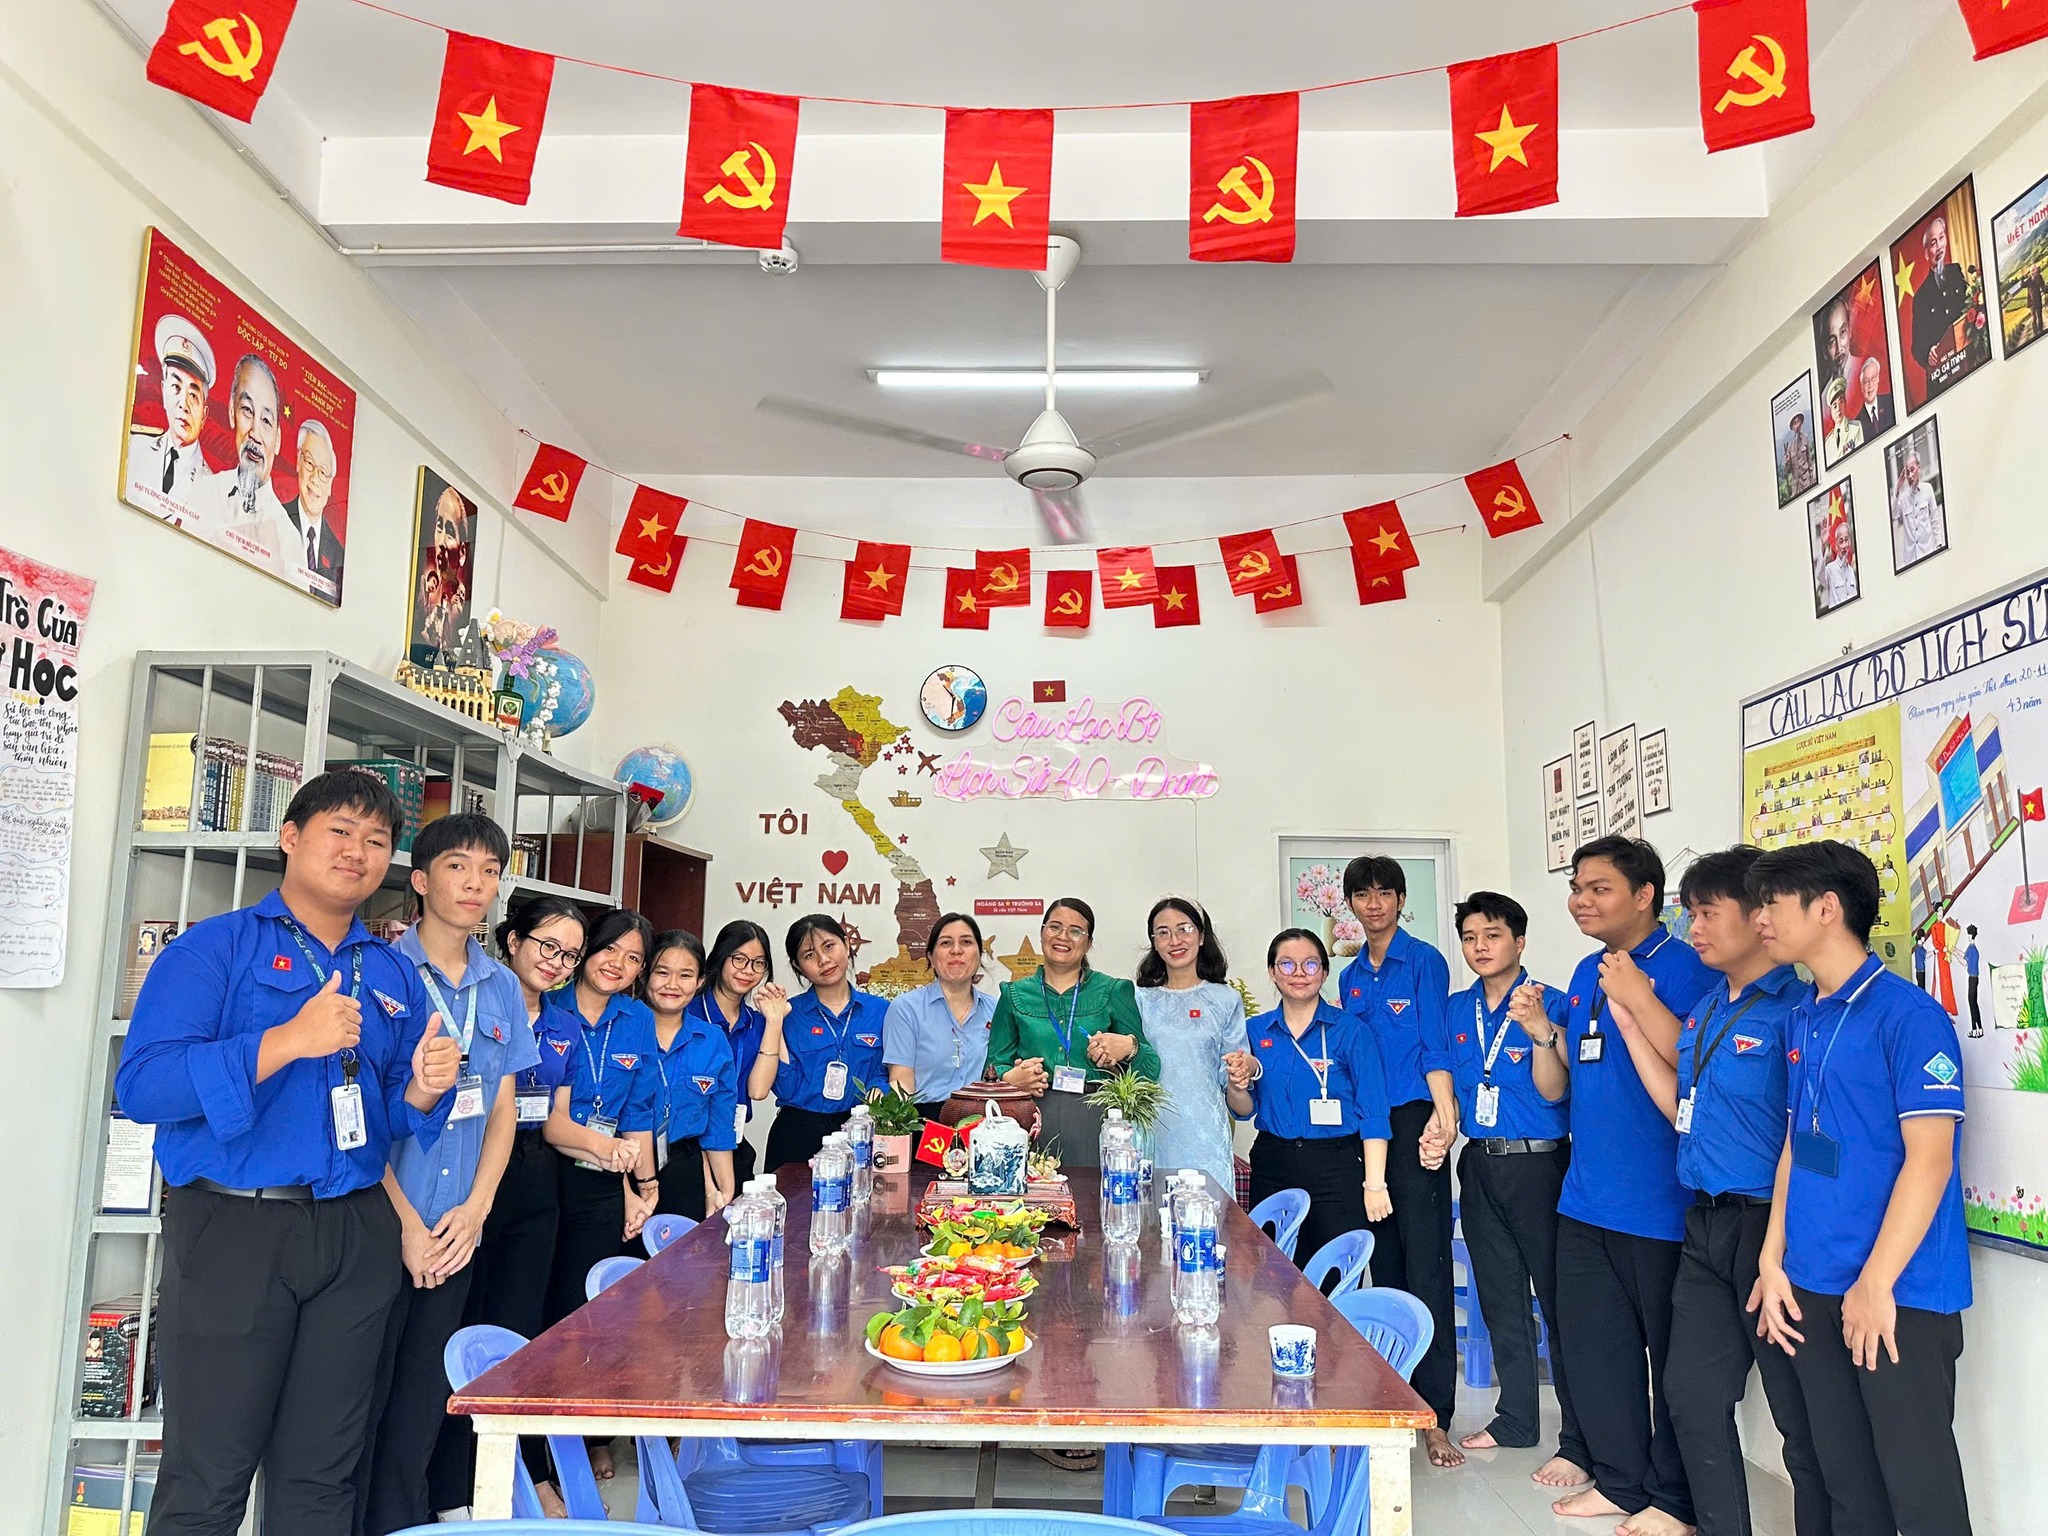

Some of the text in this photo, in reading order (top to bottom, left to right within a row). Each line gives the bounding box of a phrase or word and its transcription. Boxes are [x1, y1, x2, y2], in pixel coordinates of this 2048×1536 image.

[237, 325, 252, 342] ĐỘC
[252, 336, 264, 351] LẬP
[268, 350, 278, 364] TỰ
[278, 358, 288, 370] DO
[1770, 690, 1812, 737] CÂU
[1815, 662, 1864, 722] LẠC
[1868, 643, 1906, 702] BỘ
[1915, 611, 1988, 687] LỊCH
[992, 696, 1054, 742] Câu
[1116, 696, 1162, 743] Bộ
[2007, 697, 2042, 713] 43 năm
[934, 751, 998, 800] Lịch
[1001, 754, 1051, 796] Sử
[758, 808, 808, 835] TÔI
[735, 876, 881, 910] VIỆT NAM
